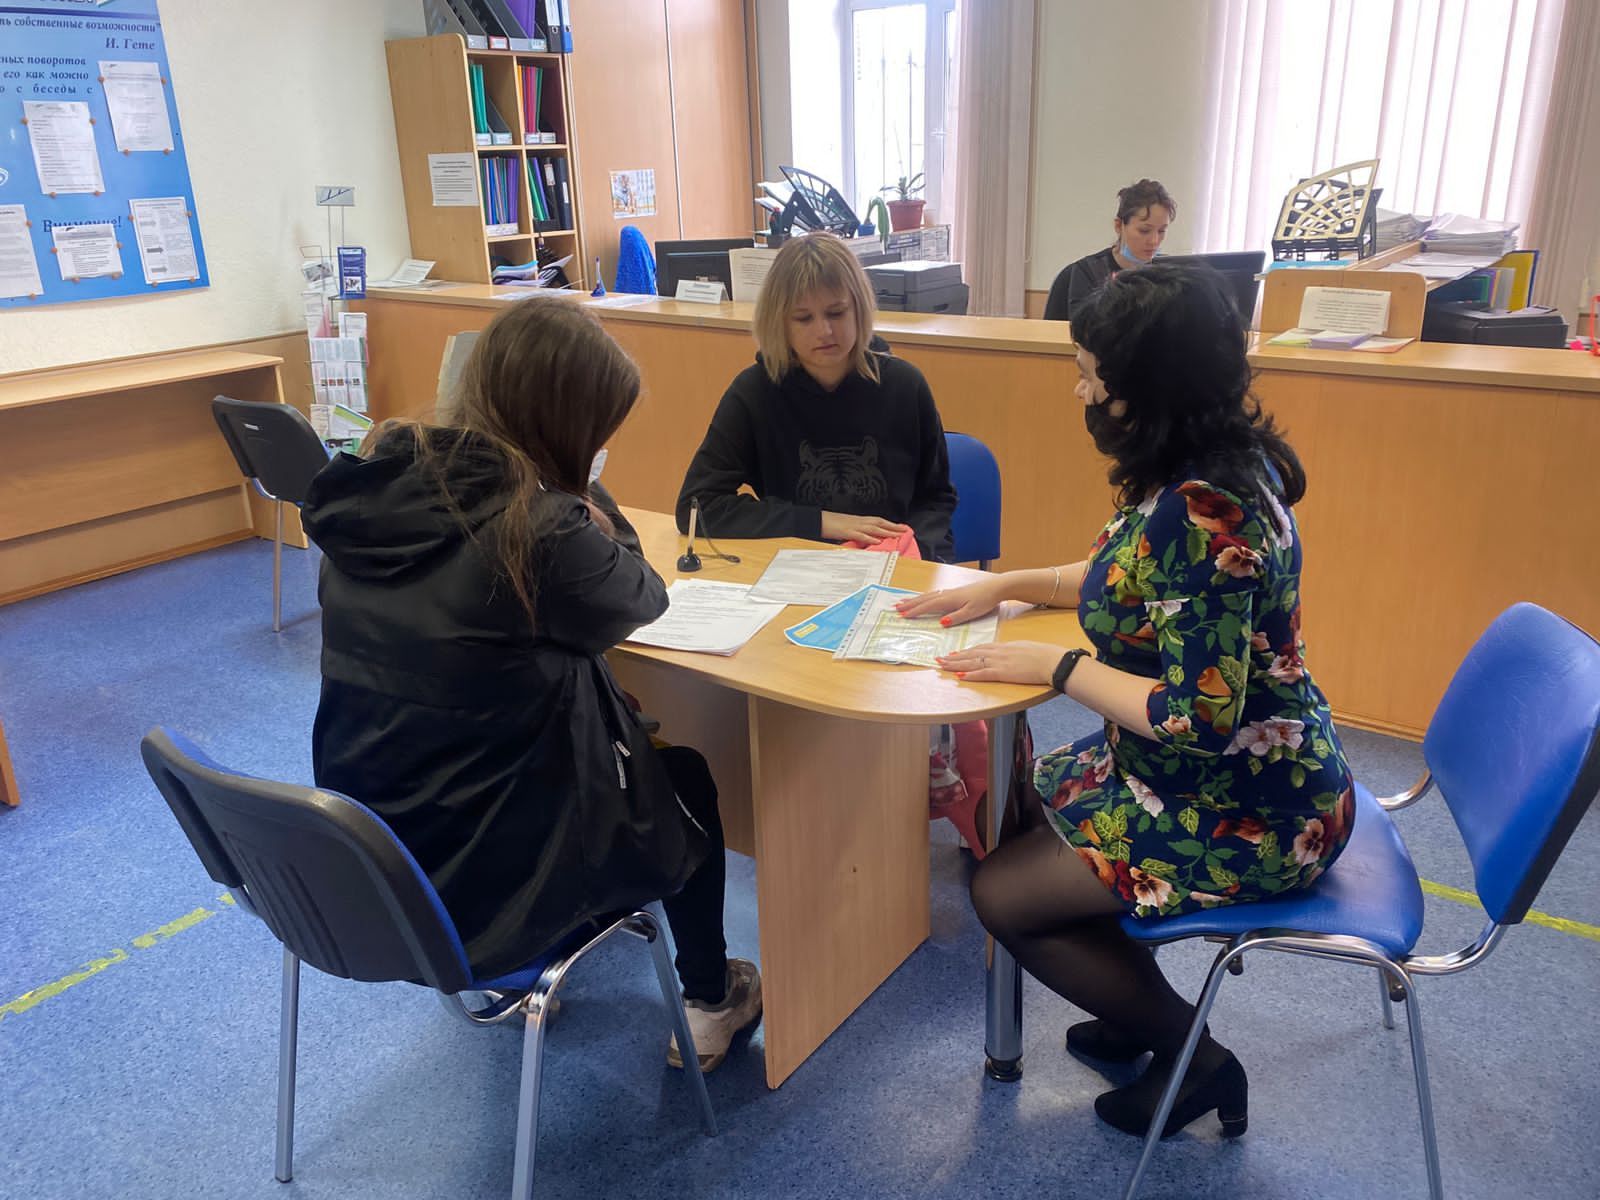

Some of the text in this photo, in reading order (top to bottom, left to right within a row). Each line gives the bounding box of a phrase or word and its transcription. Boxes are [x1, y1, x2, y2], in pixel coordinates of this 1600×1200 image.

[14, 16, 83, 29] собственные
[105, 38, 155, 50] И. Гете
[0, 56, 86, 67] ных поворотов
[3, 71, 89, 80] его как можно
[33, 83, 76, 94] беседы
[86, 86, 93, 94] с
